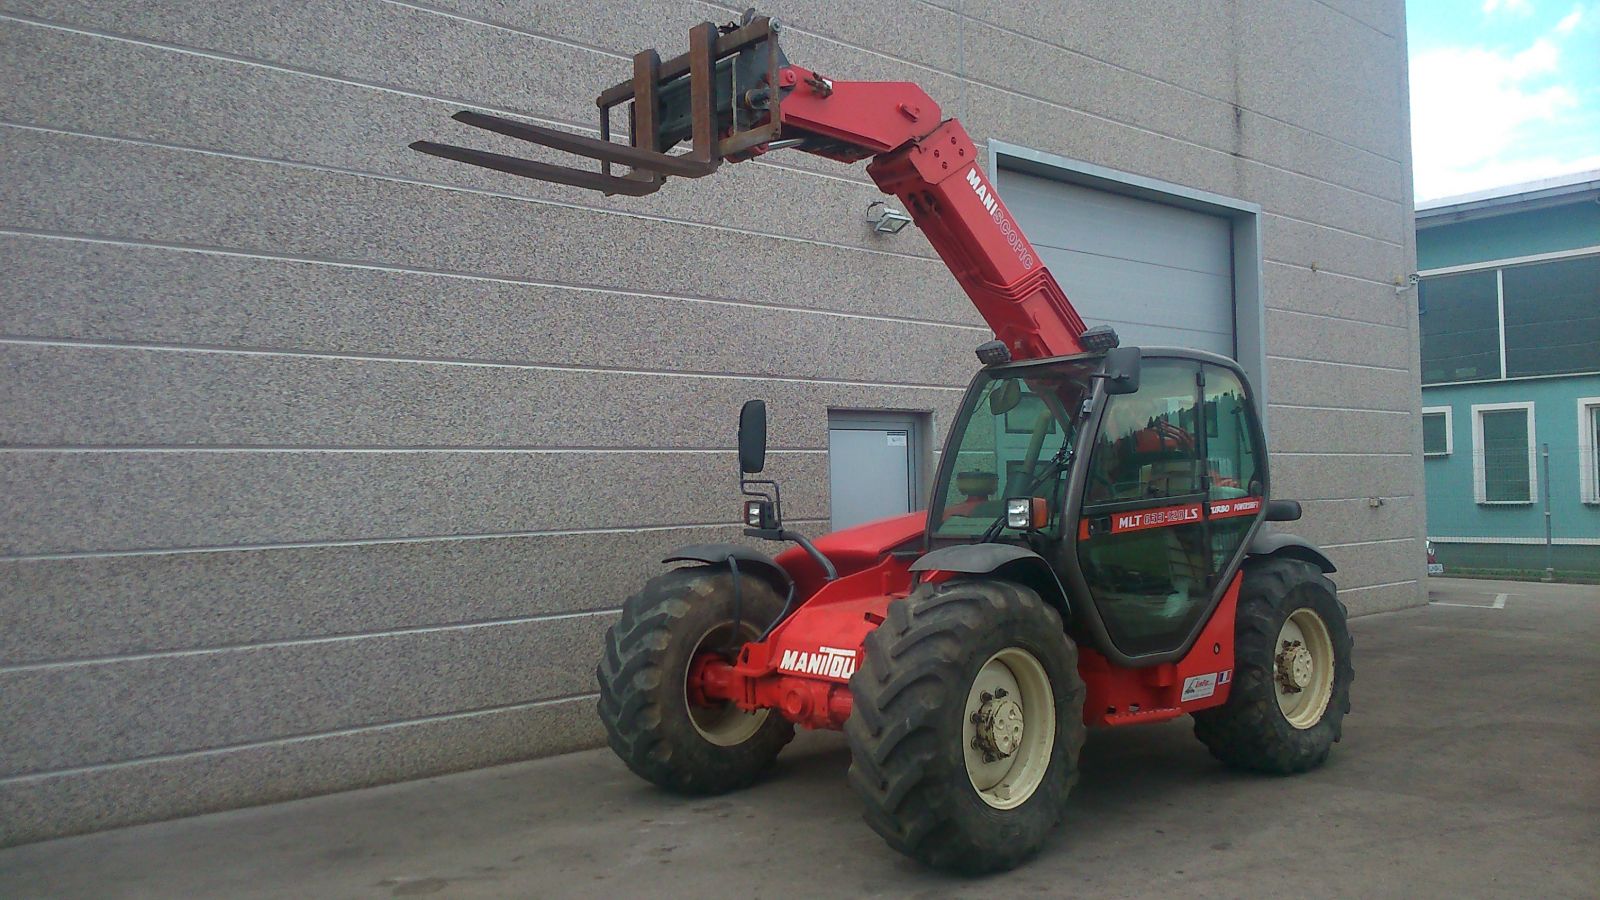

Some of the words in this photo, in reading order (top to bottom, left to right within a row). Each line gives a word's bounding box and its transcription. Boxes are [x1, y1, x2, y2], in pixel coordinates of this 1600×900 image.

[966, 168, 1033, 270] MANISCOPIC
[1119, 514, 1143, 529] MLT
[780, 646, 856, 679] MANITOU
